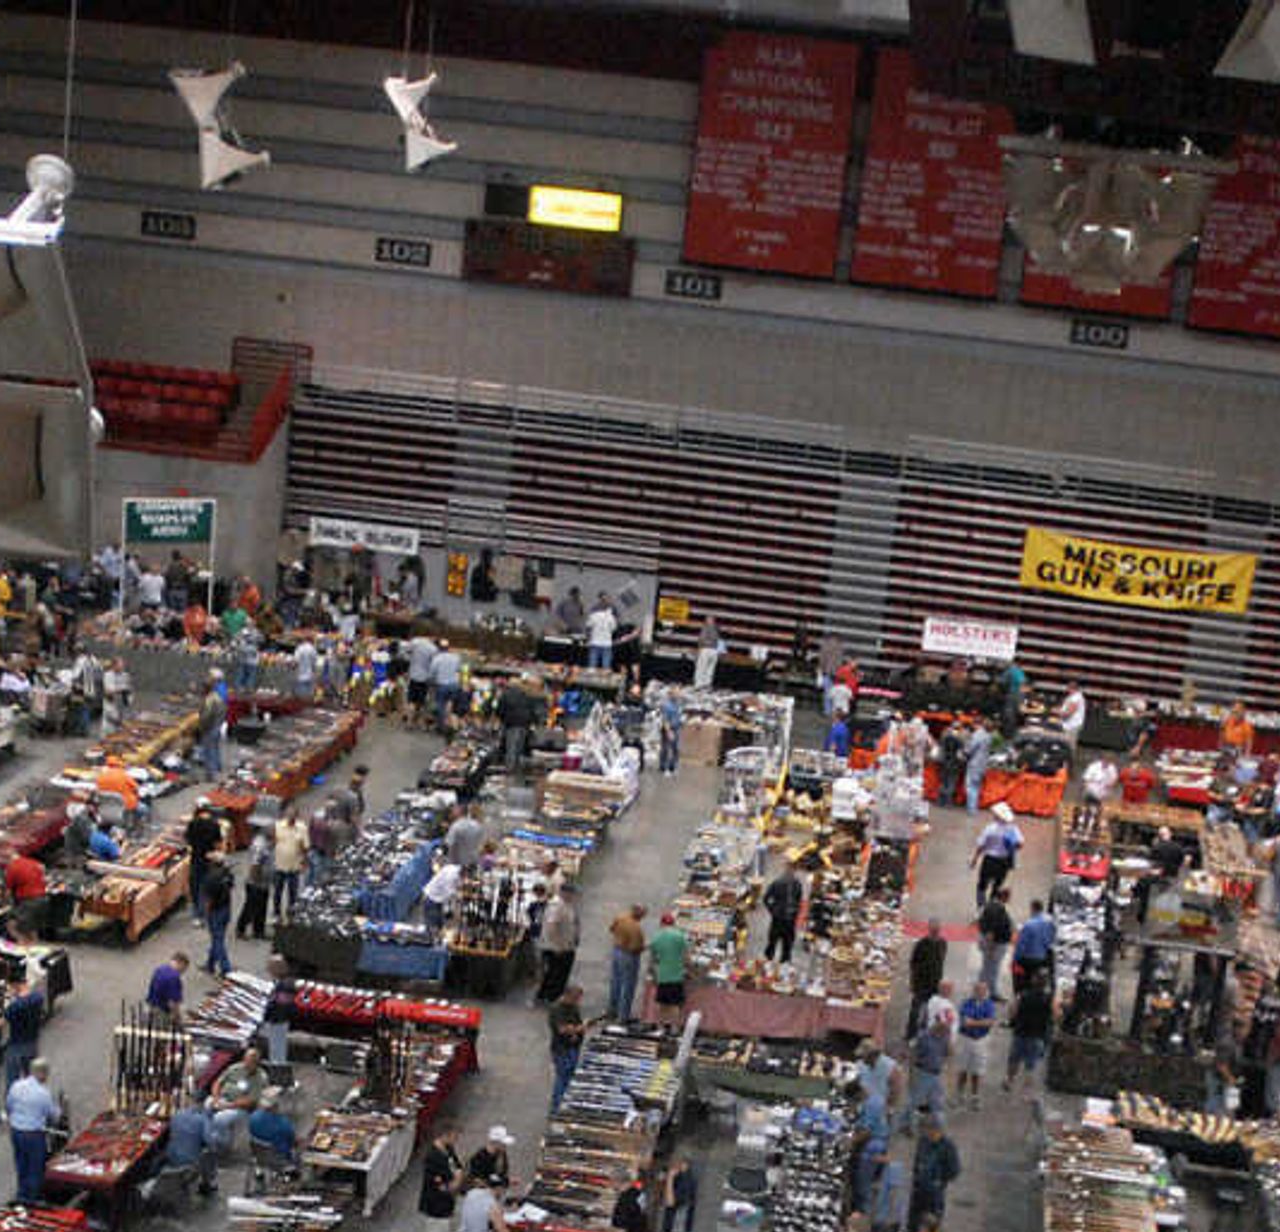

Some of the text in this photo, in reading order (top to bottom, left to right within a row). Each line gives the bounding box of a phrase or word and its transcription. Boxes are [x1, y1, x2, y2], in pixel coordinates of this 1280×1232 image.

[378, 241, 429, 263] 102
[673, 276, 717, 298] 101
[1074, 326, 1126, 347] 100
[1062, 543, 1218, 580] MISSOURI
[1035, 560, 1238, 605] GUN & KNIFE
[930, 622, 1012, 644] HOLSTERS
